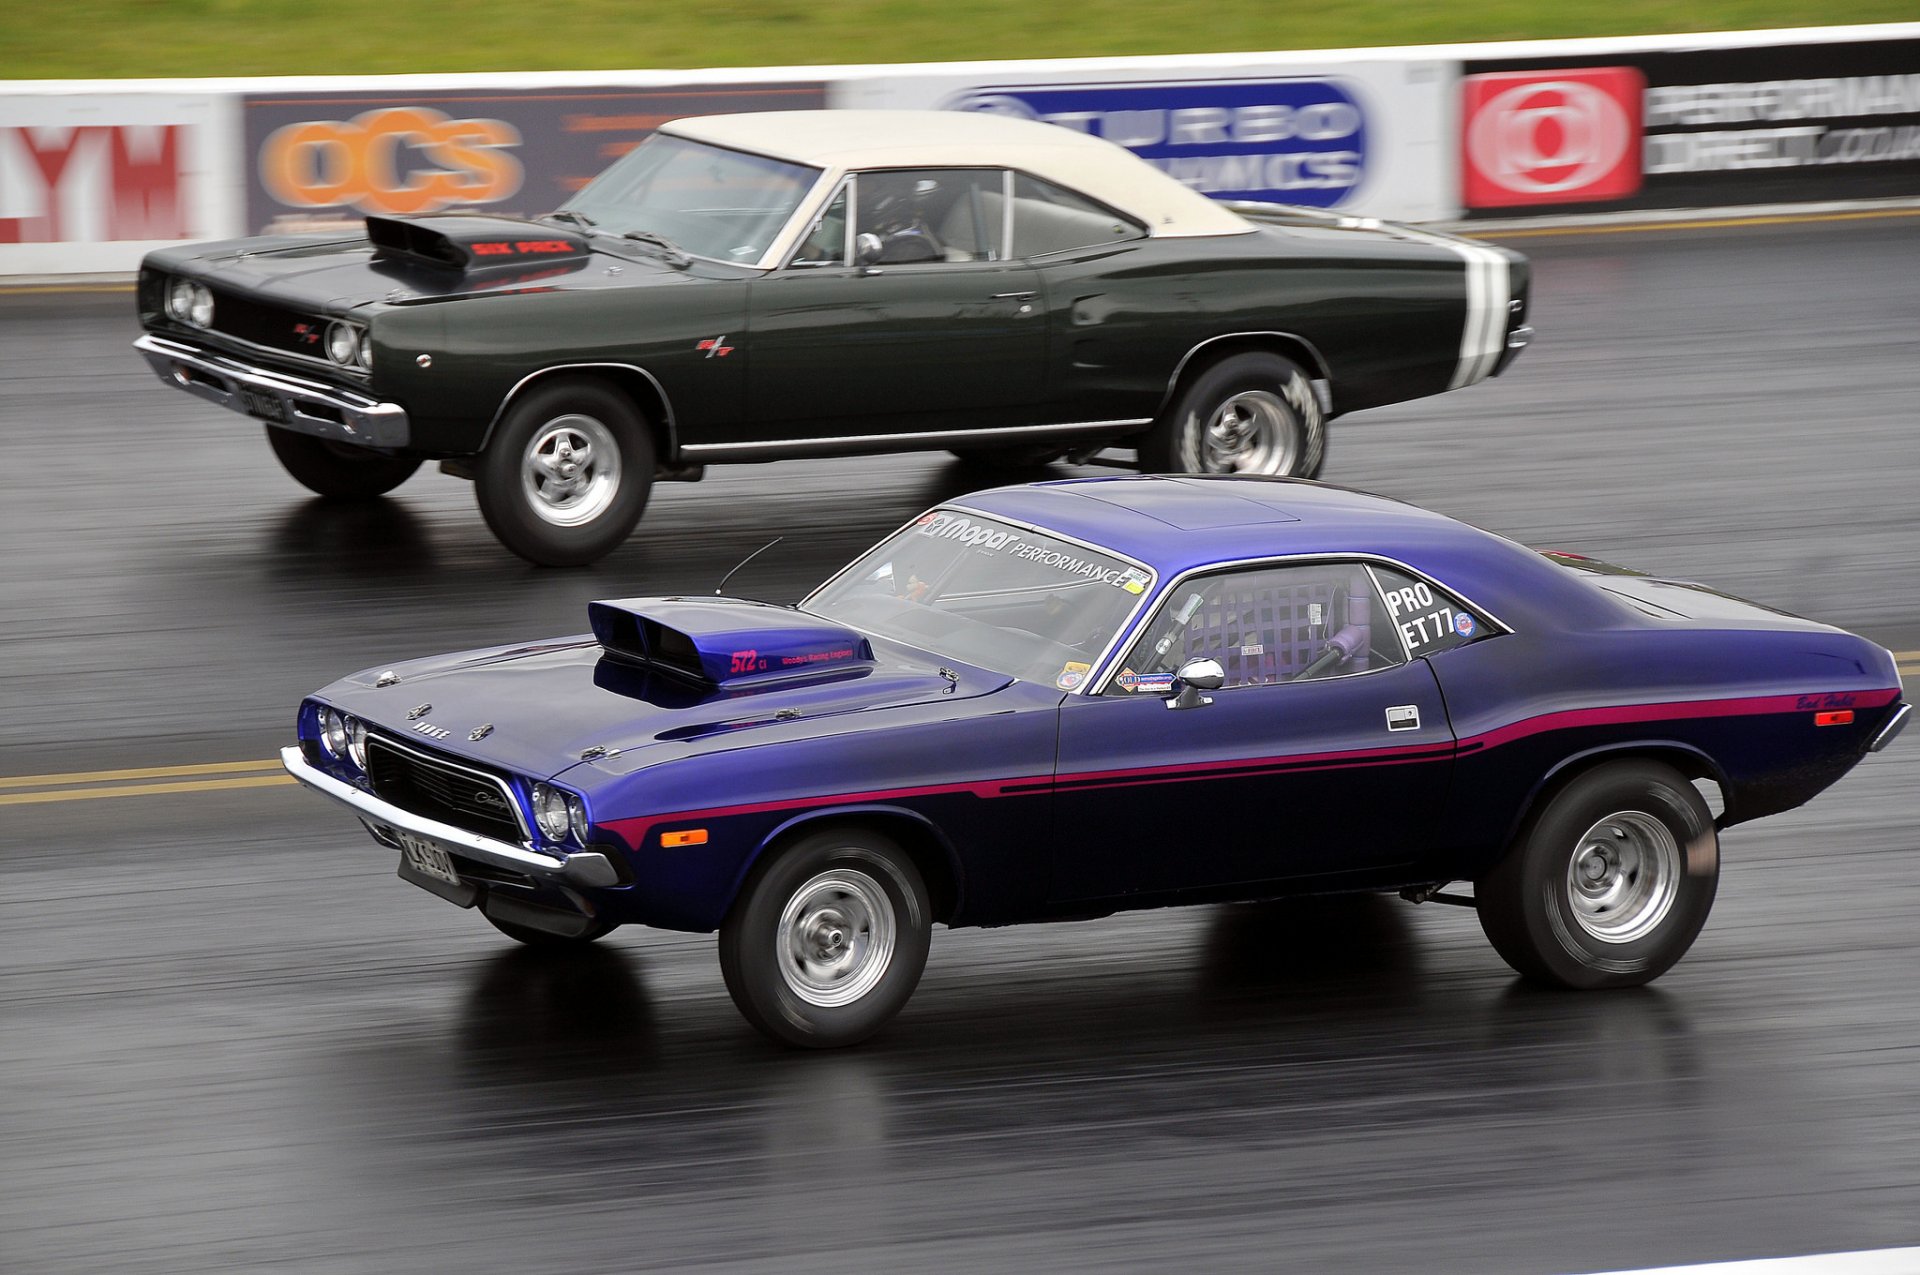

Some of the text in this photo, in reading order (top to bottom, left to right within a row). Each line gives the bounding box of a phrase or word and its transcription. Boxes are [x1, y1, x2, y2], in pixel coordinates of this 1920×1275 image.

[695, 335, 735, 358] R/T
[1009, 541, 1129, 588] PERFORMANCE
[1386, 582, 1434, 617] PRO
[1400, 616, 1430, 650] ET
[1427, 607, 1455, 638] 77
[731, 649, 757, 672] 572
